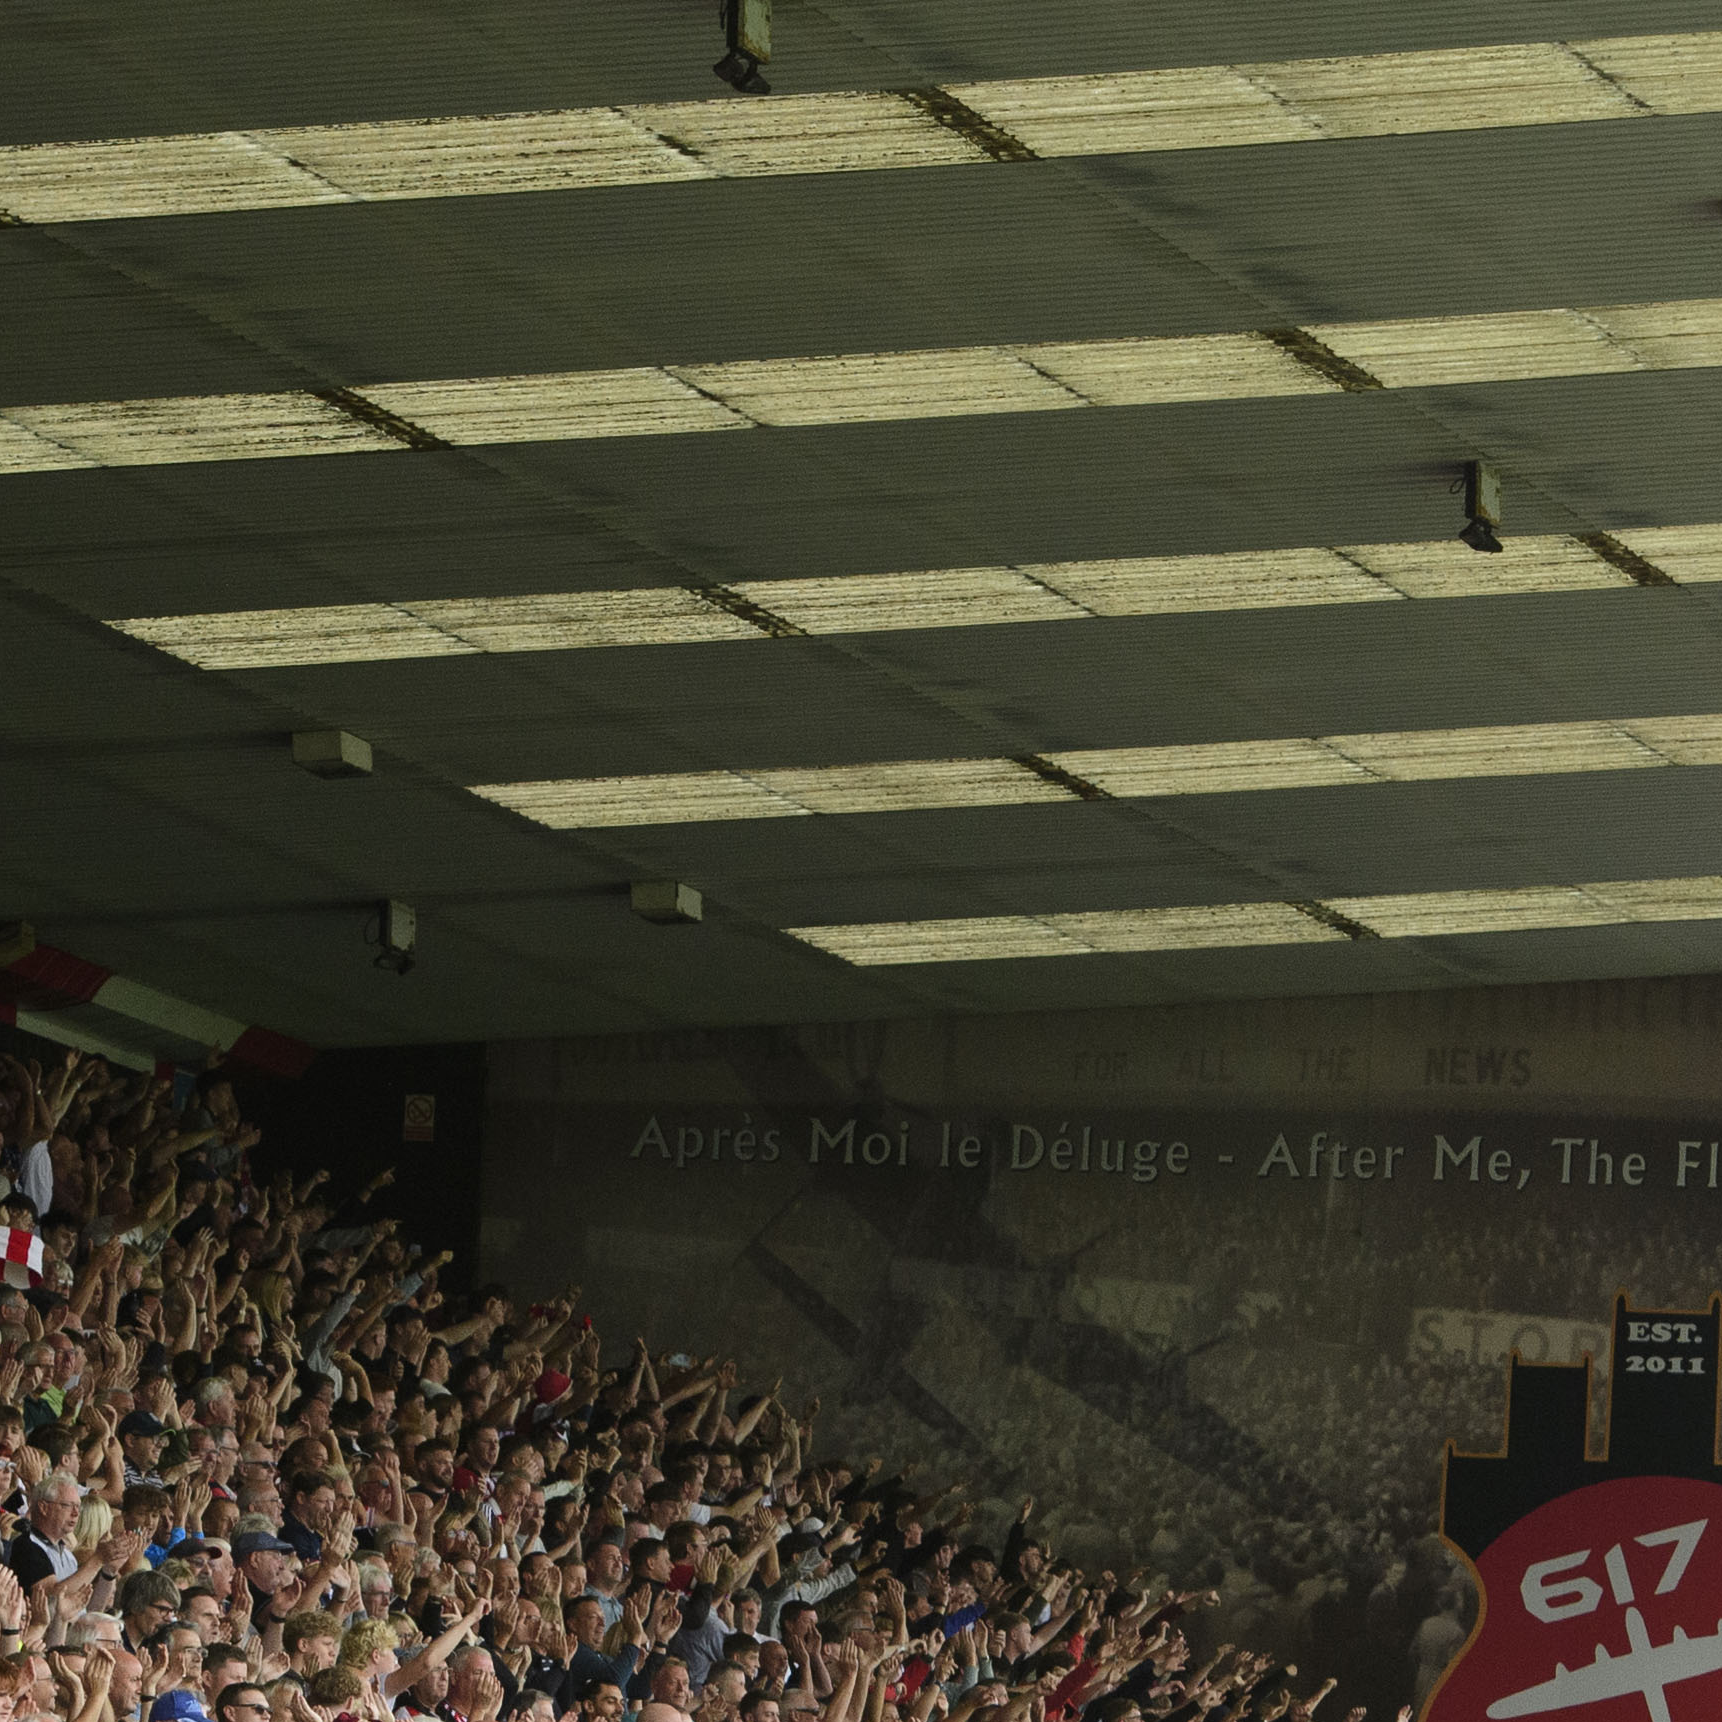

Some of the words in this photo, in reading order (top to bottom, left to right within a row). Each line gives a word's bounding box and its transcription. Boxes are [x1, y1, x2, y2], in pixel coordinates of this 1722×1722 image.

[1176, 1048, 1236, 1082] ALL
[1294, 1046, 1355, 1083] THE
[1423, 1048, 1533, 1086] NEWS
[629, 1115, 780, 1168] Après
[810, 1118, 909, 1166] Moi
[942, 1123, 981, 1169] le
[1010, 1123, 1190, 1182] Déluge
[1258, 1133, 1404, 1183] After
[1434, 1136, 1531, 1190] Me,
[1551, 1138, 1646, 1187] The
[1627, 1321, 1703, 1345] EST.
[1625, 1354, 1706, 1376] 2011
[1520, 1518, 1710, 1625] 617
